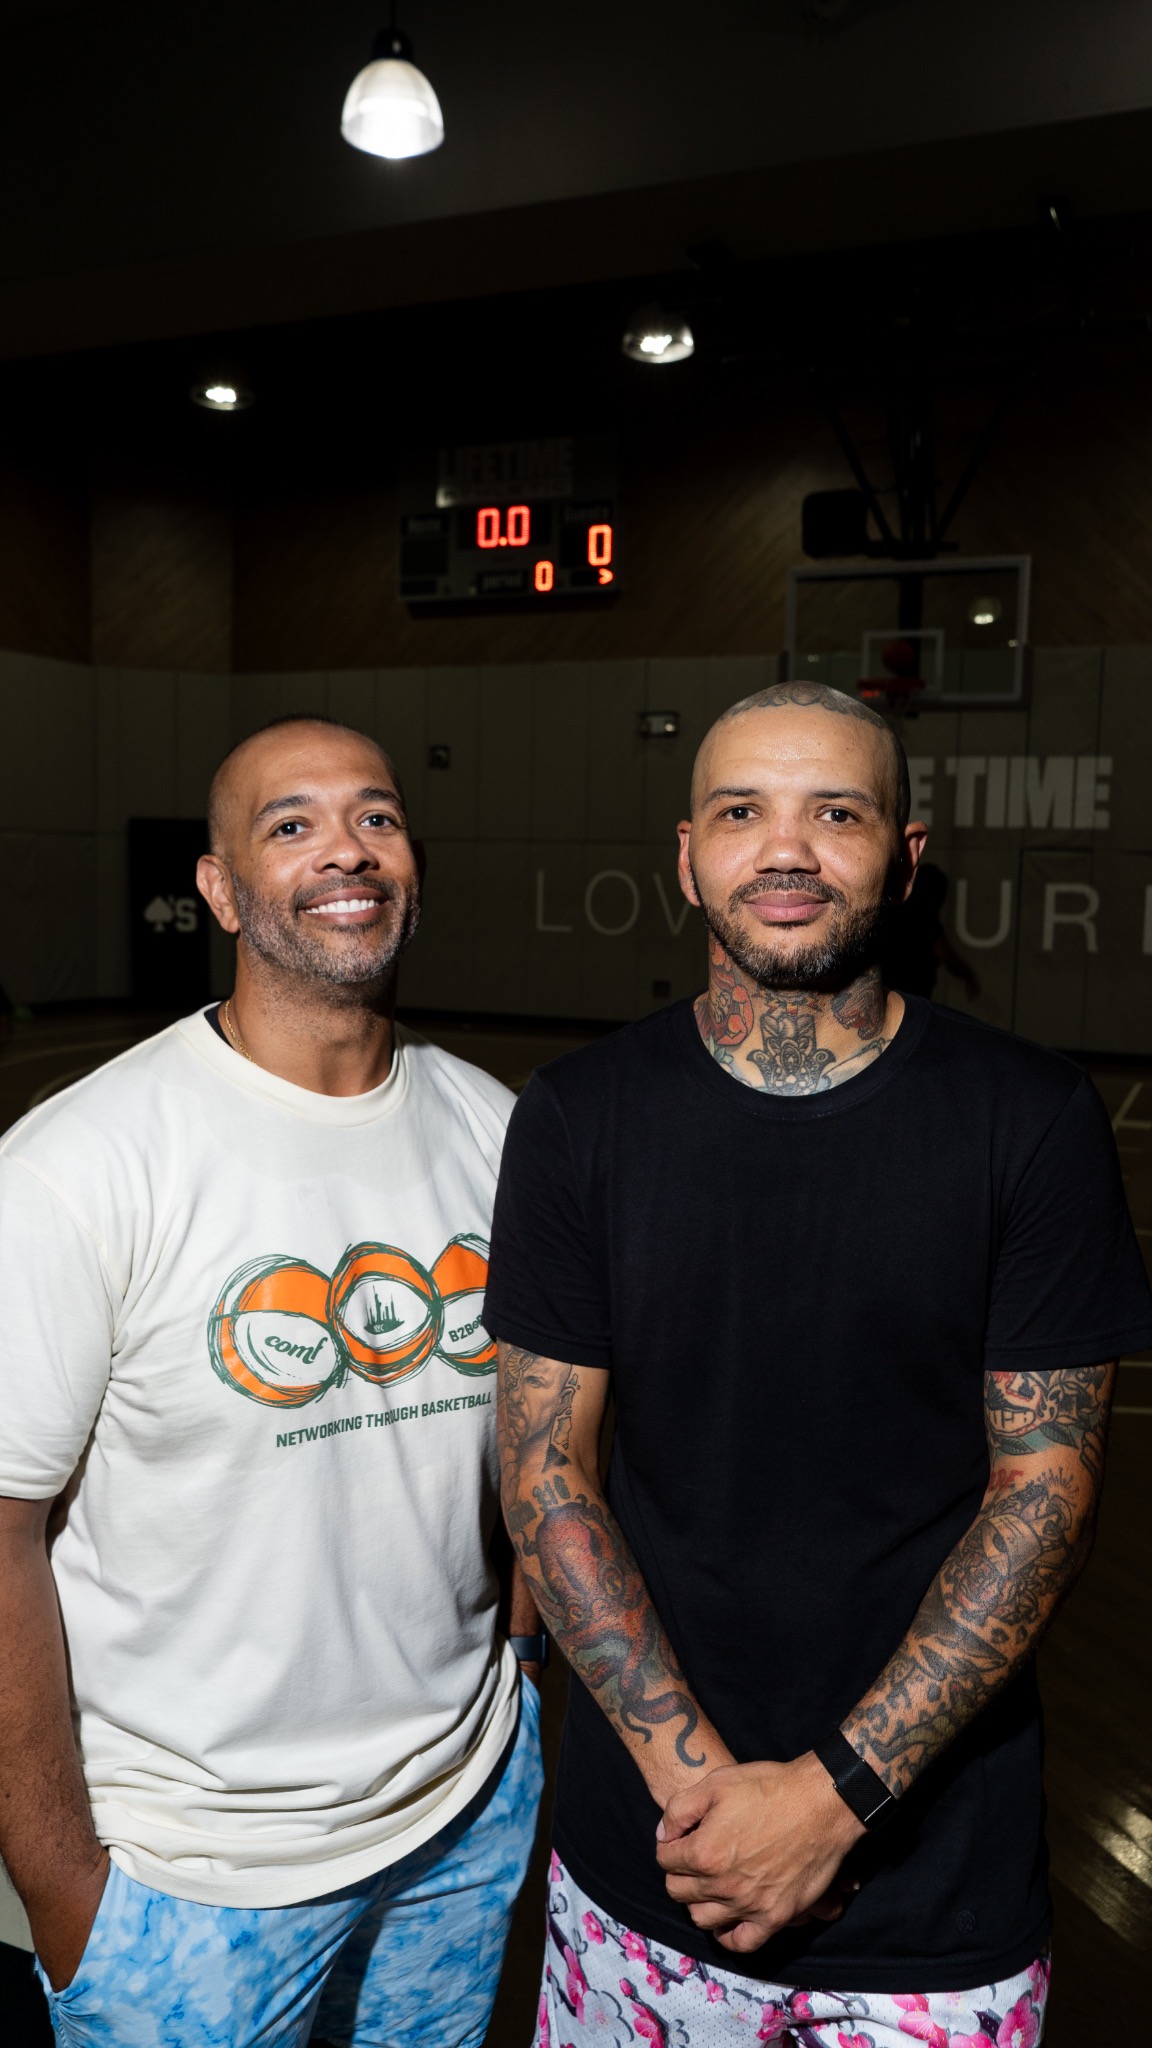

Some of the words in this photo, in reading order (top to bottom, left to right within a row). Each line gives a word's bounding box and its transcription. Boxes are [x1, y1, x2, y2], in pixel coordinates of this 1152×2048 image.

[476, 505, 531, 549] 0.0
[587, 523, 613, 567] 0
[534, 560, 554, 592] 0
[946, 756, 1113, 829] TIME
[536, 869, 691, 936] LOV
[264, 1336, 329, 1365] comf
[276, 1416, 363, 1448] NETWORKING
[365, 1405, 419, 1429] THROUGH
[421, 1391, 492, 1418] BASKETBALL
